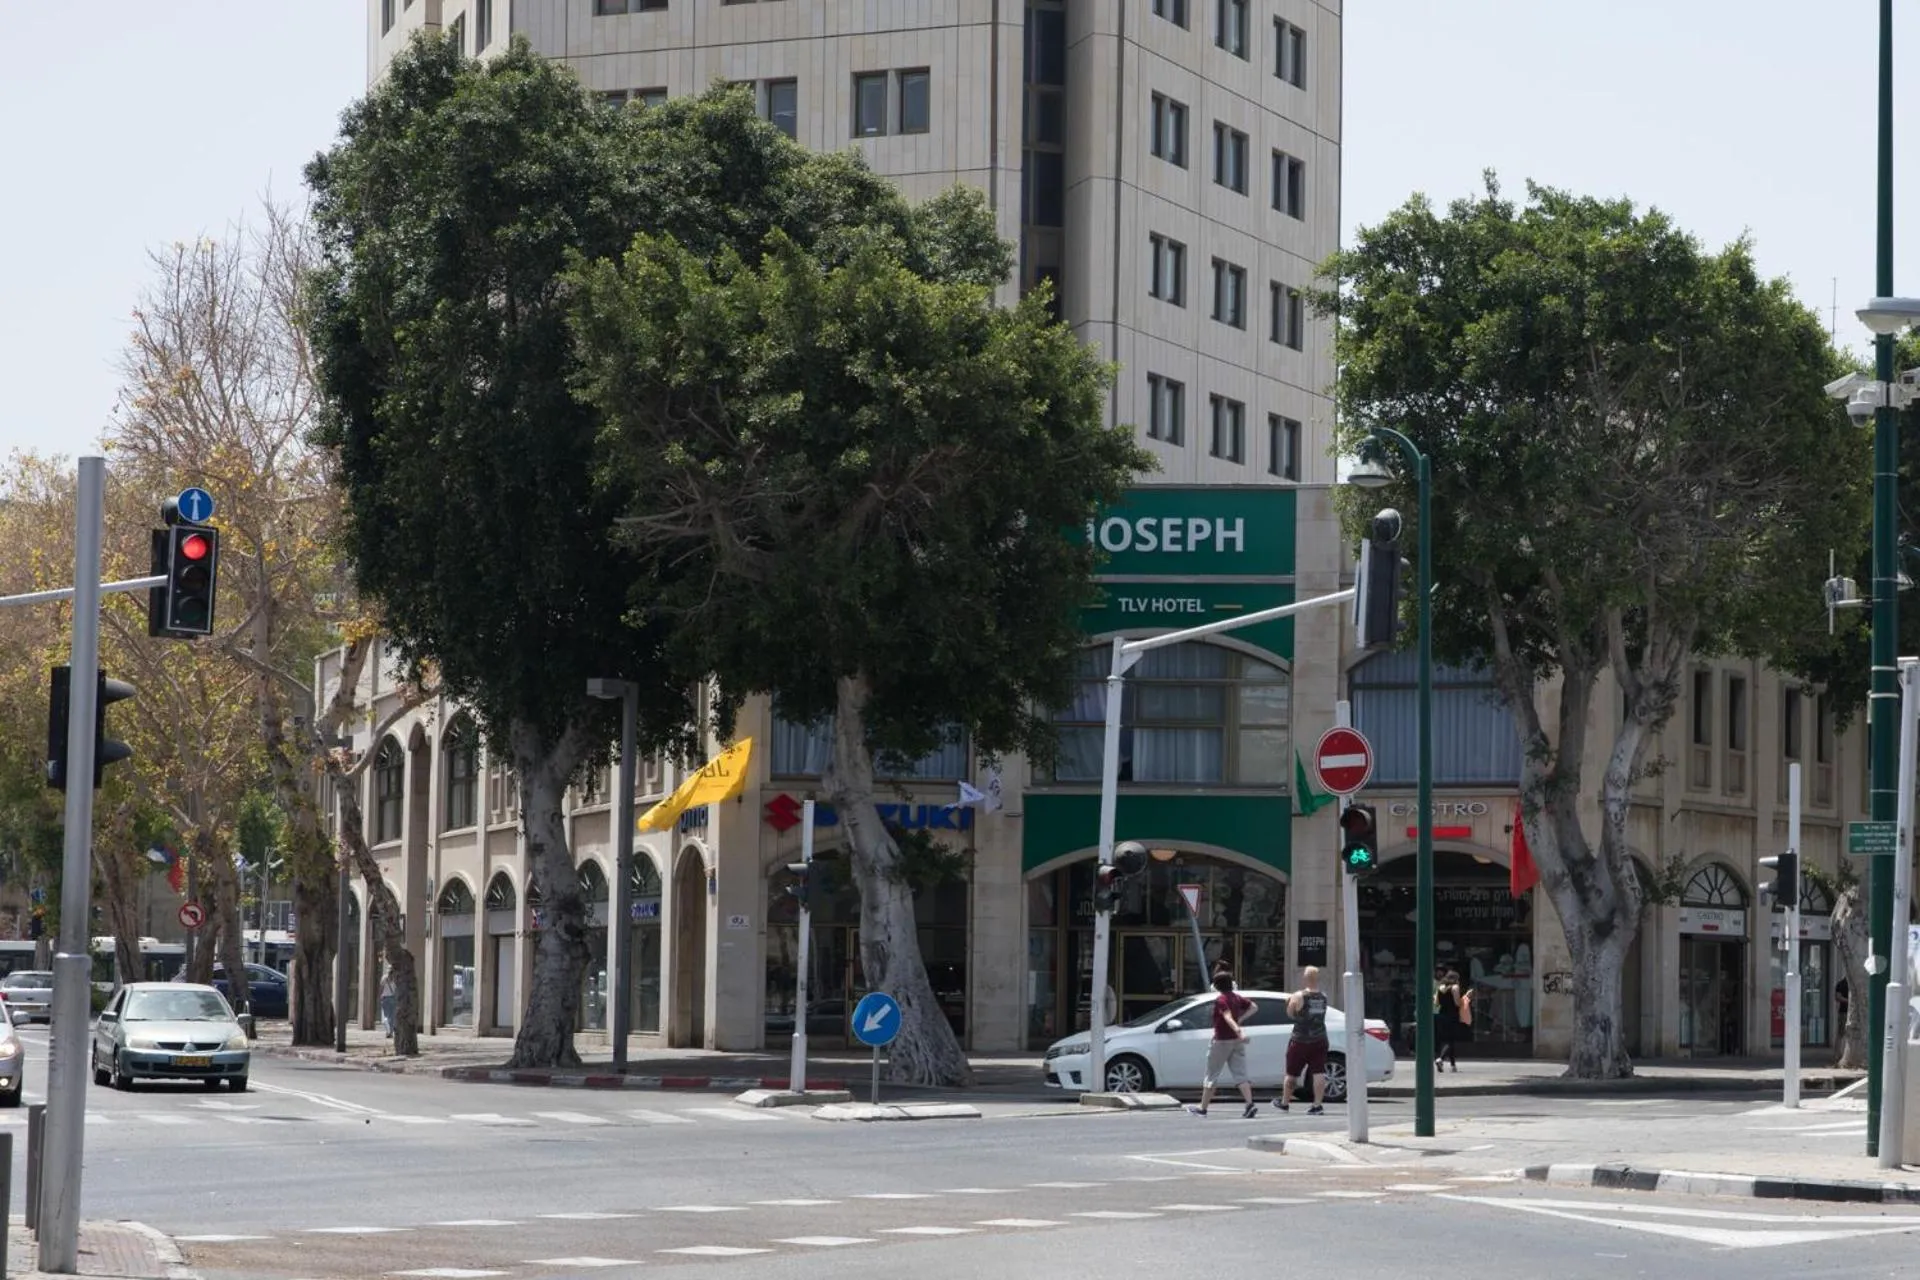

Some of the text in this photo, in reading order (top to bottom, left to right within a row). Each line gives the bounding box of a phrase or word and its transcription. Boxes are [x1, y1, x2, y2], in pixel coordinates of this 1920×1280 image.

[1118, 598, 1206, 613] TLV HOTEL
[813, 803, 974, 830] SZUKI
